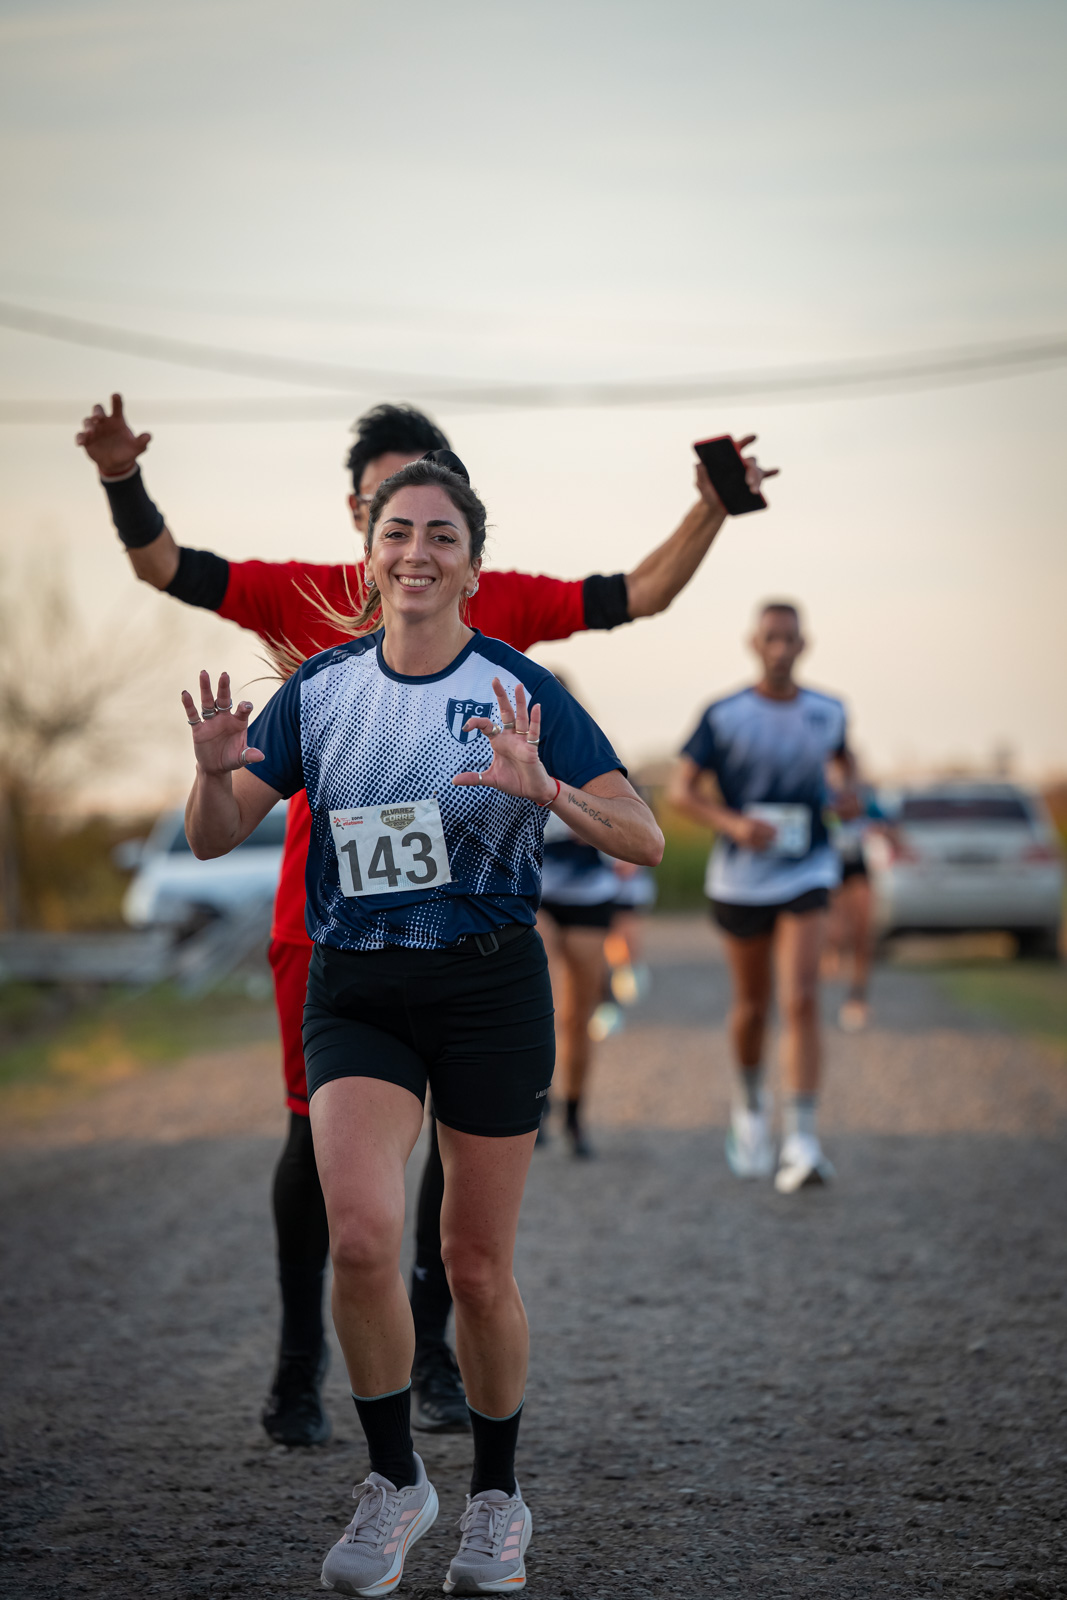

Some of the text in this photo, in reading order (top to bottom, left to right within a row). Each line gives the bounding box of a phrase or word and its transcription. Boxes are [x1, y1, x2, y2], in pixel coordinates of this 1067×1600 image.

[454, 702, 484, 715] SFC
[381, 807, 416, 816] ALVAREZ
[383, 813, 414, 823] CORRE
[340, 831, 437, 892] 143
